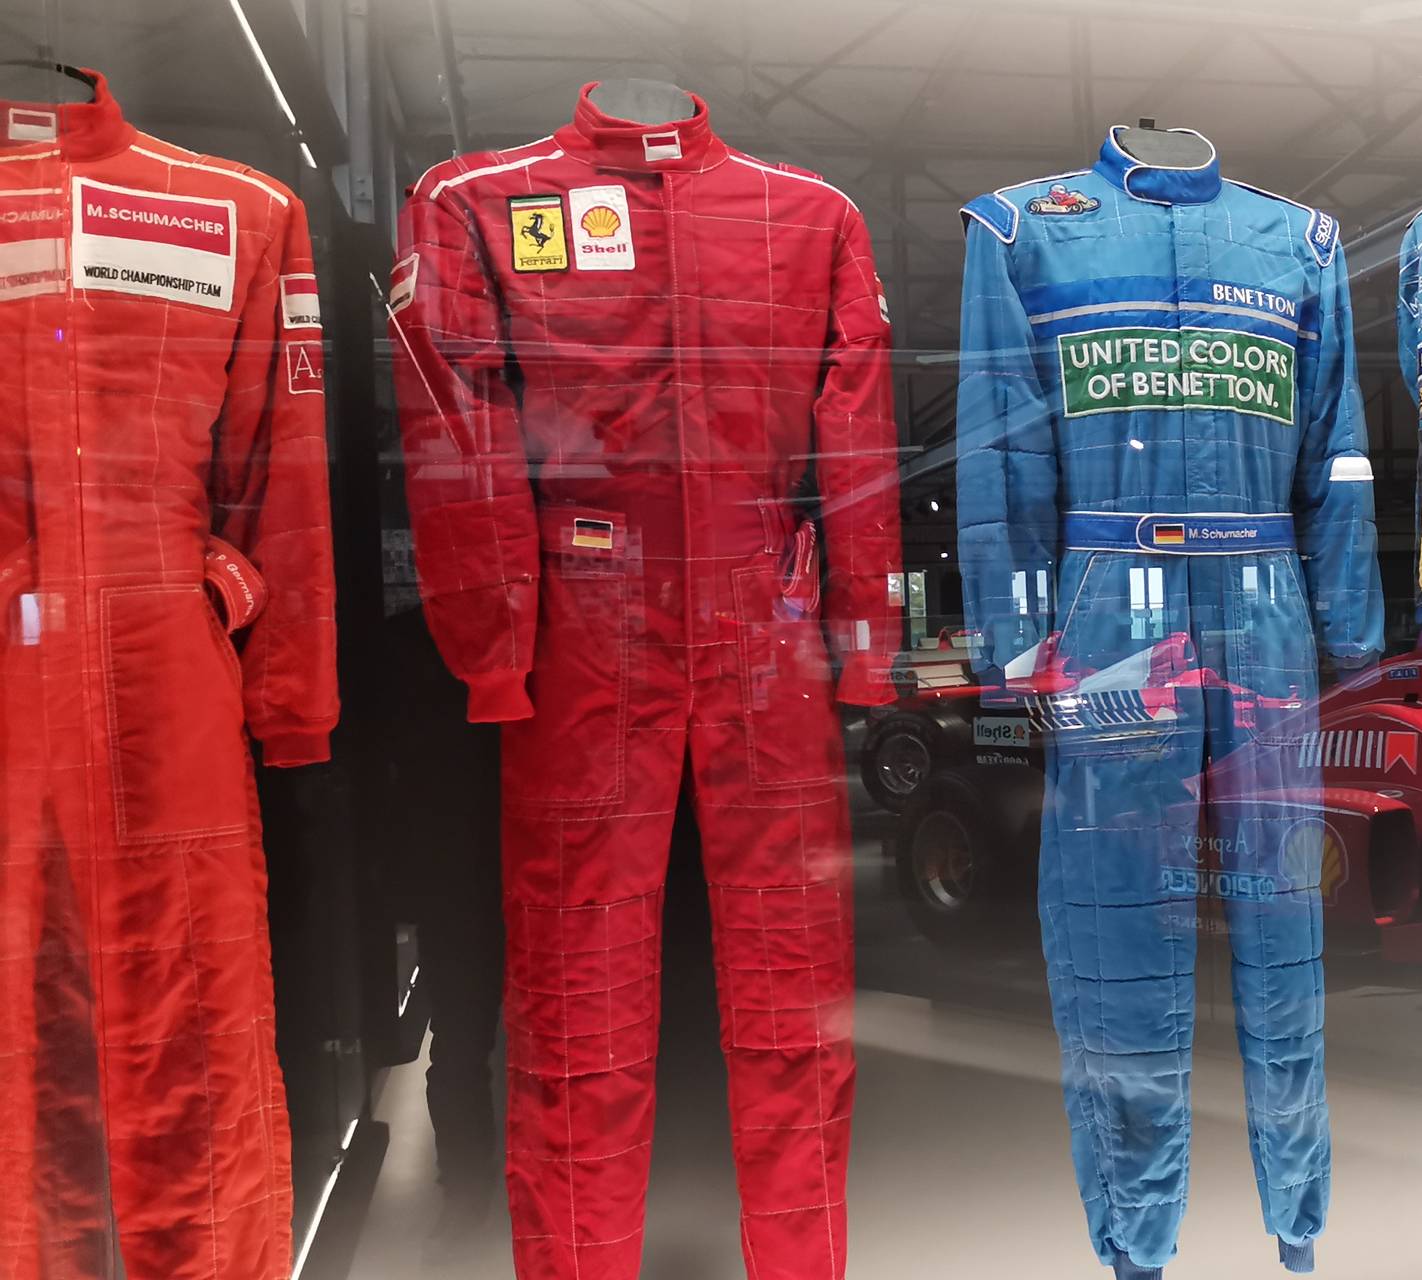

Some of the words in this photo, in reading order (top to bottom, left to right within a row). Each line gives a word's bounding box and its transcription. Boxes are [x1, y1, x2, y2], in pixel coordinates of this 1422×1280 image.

[86, 202, 225, 236] M.SCHUMACHER
[519, 255, 564, 267] Ferrari
[581, 243, 627, 254] Shell
[83, 265, 119, 280] WORLD
[120, 267, 196, 294] CHAMPIONSHIP
[196, 279, 222, 298] TEAM
[1212, 283, 1296, 317] BENETTON
[1069, 338, 1181, 369] UNITED
[1189, 339, 1288, 379] COLORS
[1087, 373, 1126, 400] OF
